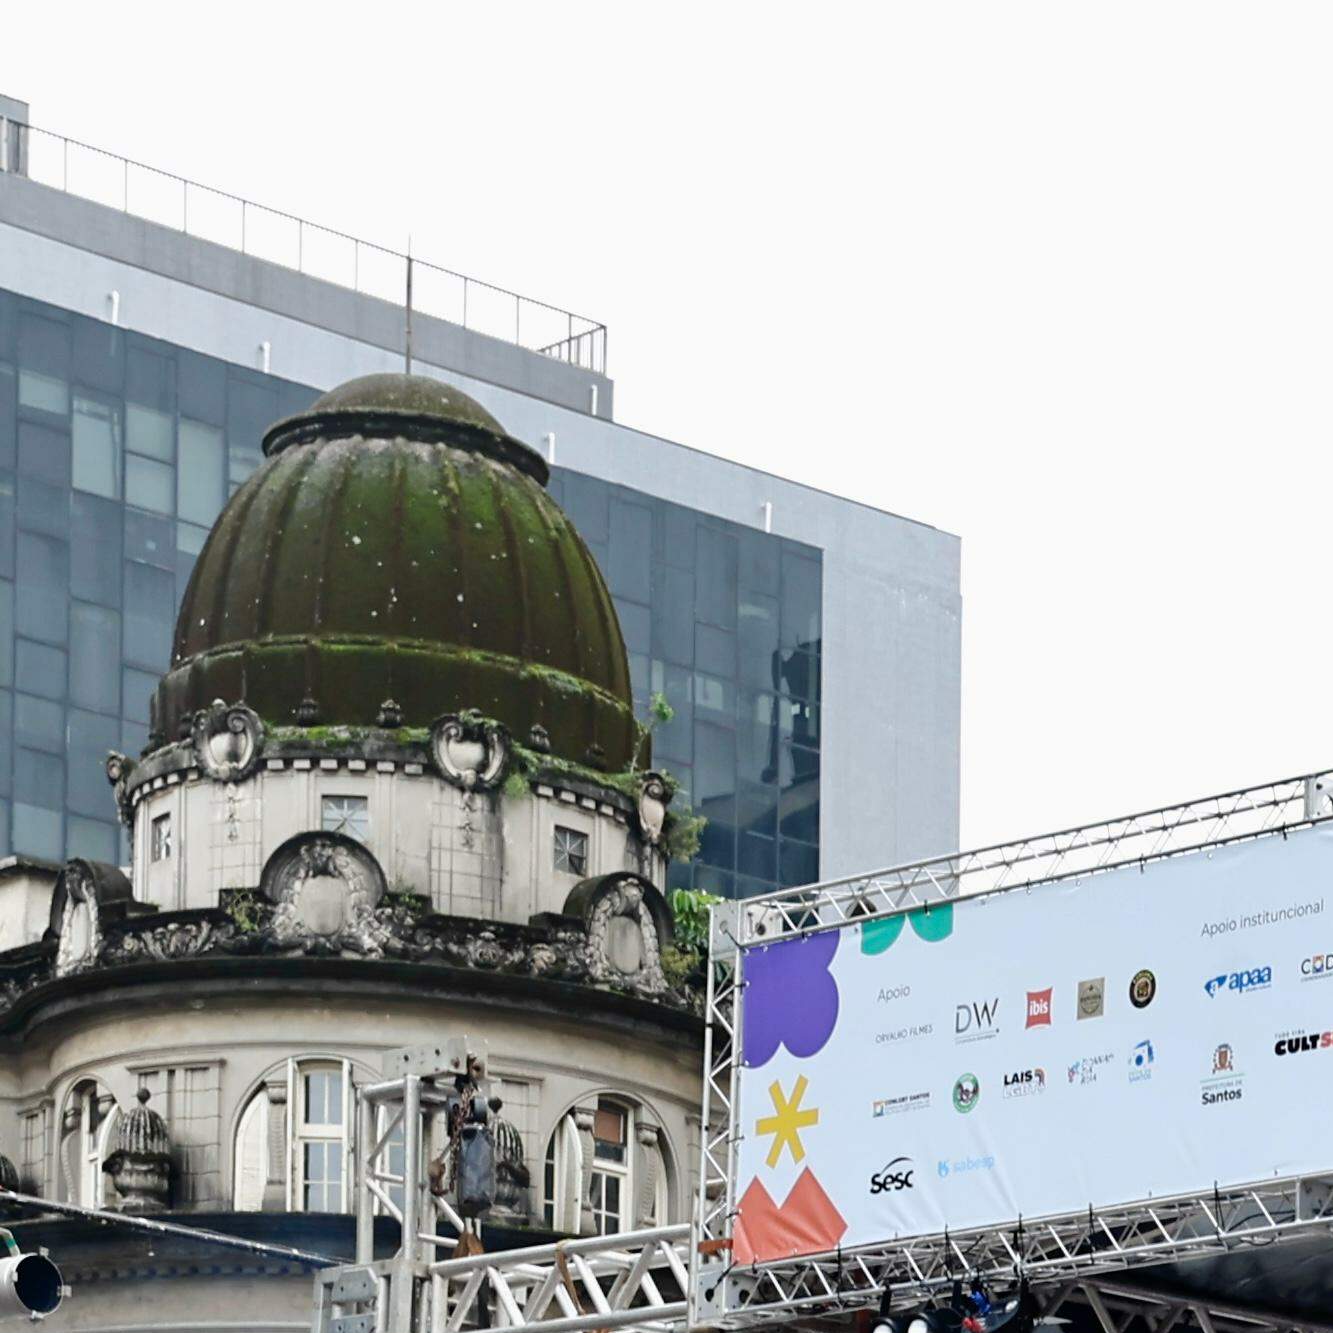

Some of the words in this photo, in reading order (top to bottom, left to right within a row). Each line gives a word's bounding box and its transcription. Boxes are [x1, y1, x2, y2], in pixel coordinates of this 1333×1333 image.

[1200, 919, 1237, 938] Apoio
[1228, 966, 1272, 993] apaa
[877, 985, 911, 1003] Apoio
[1029, 998, 1048, 1016] ibis
[910, 1024, 934, 1038] FILMES
[1003, 1069, 1033, 1086] LAIS
[1201, 1088, 1242, 1105] Santos
